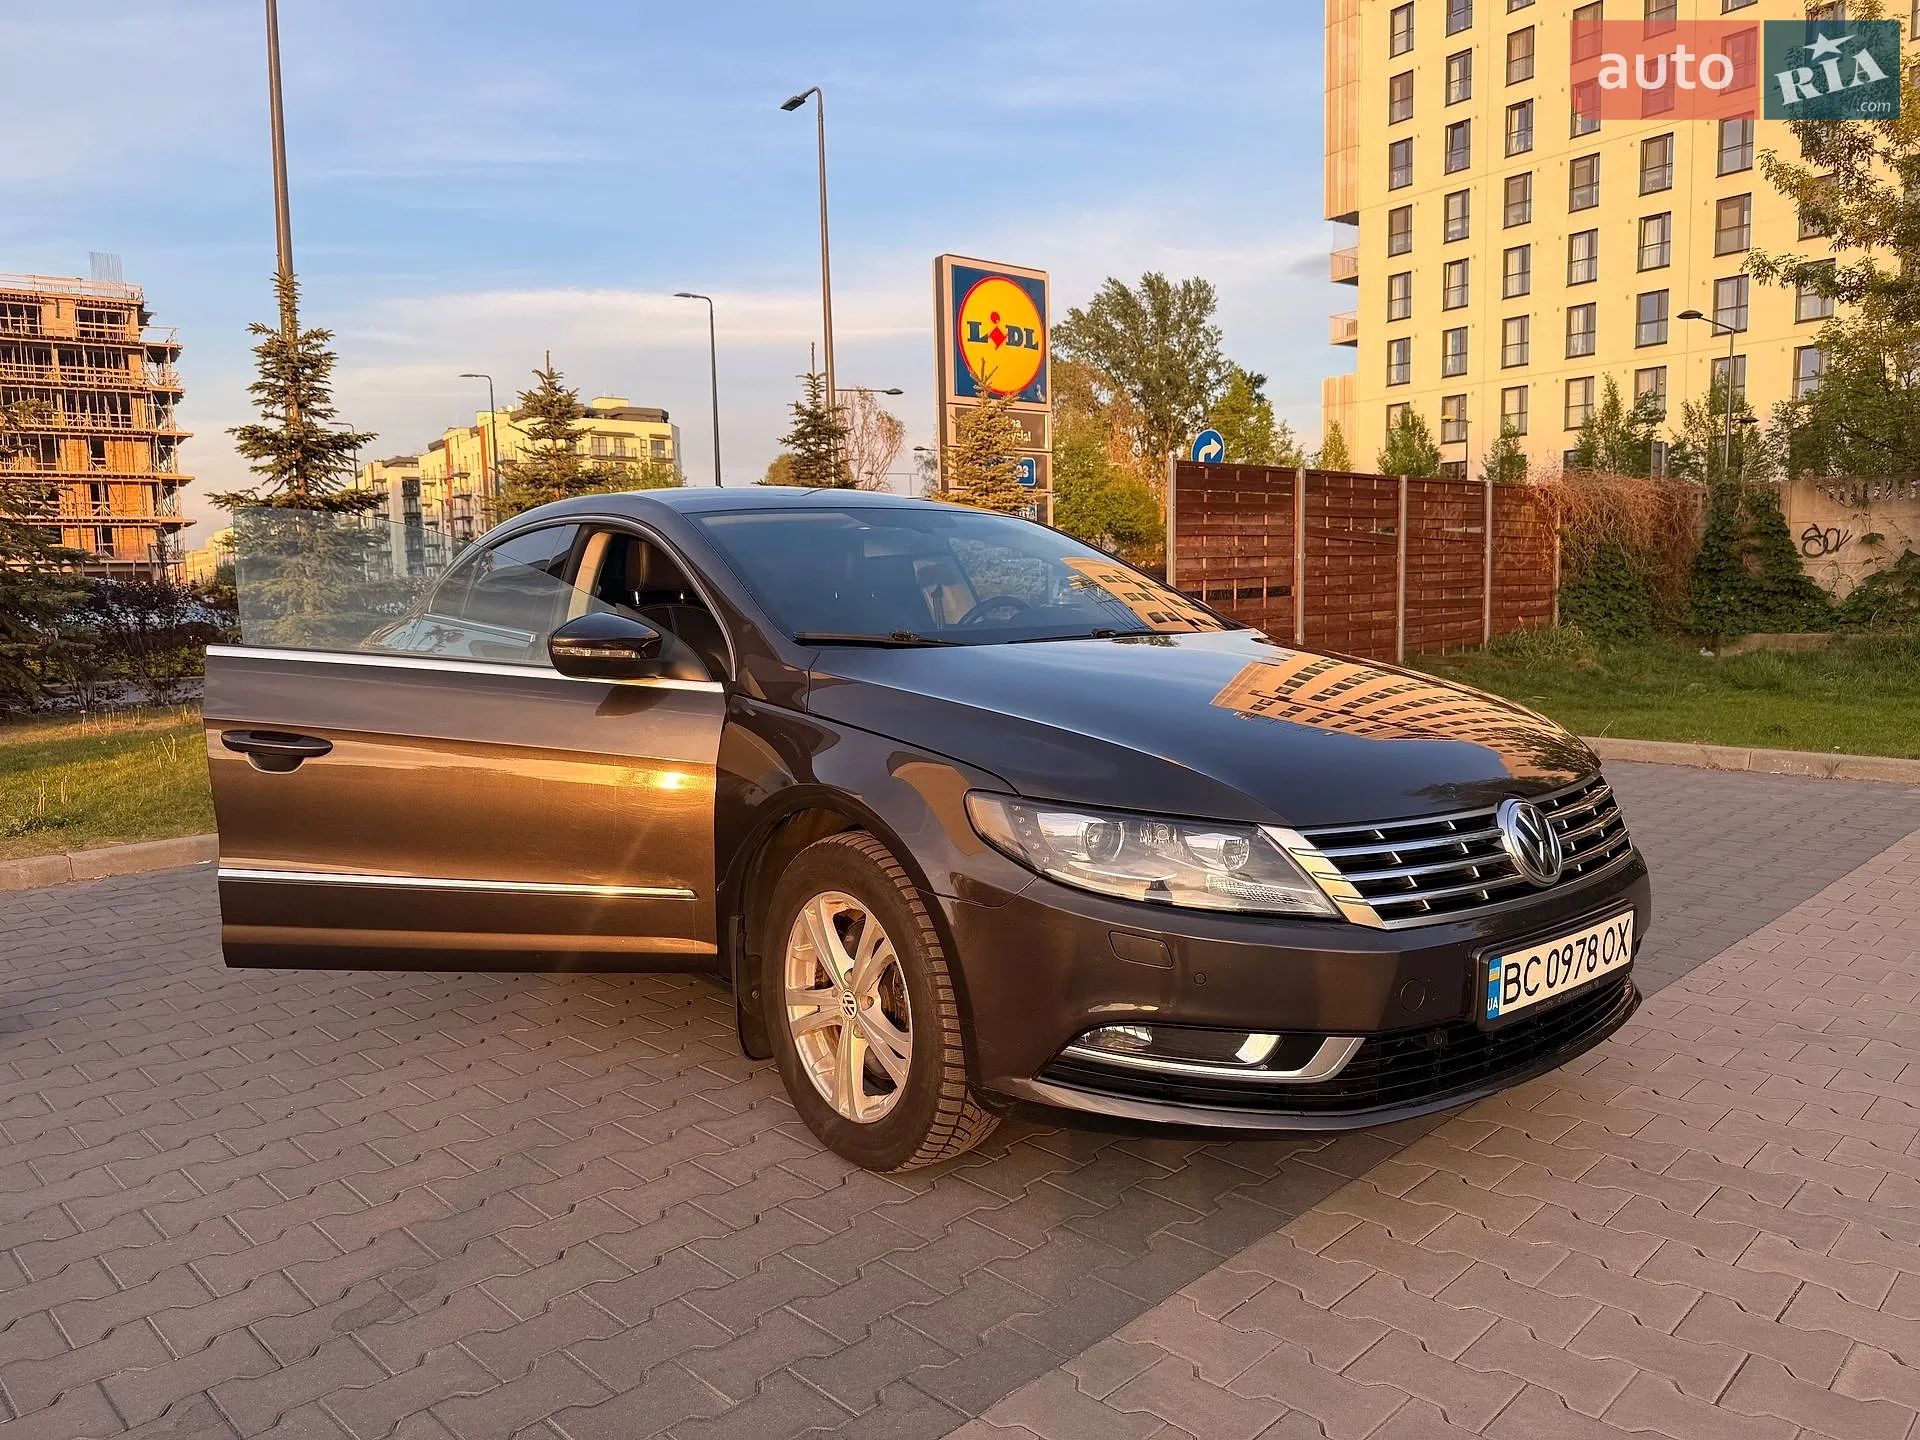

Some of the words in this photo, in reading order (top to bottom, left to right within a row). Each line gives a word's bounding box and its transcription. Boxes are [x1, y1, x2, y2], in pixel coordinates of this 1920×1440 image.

[1503, 955, 1541, 1006] BC
[1546, 933, 1599, 989] 0978
[1602, 918, 1630, 965] OX
[1487, 996, 1499, 1012] UA
